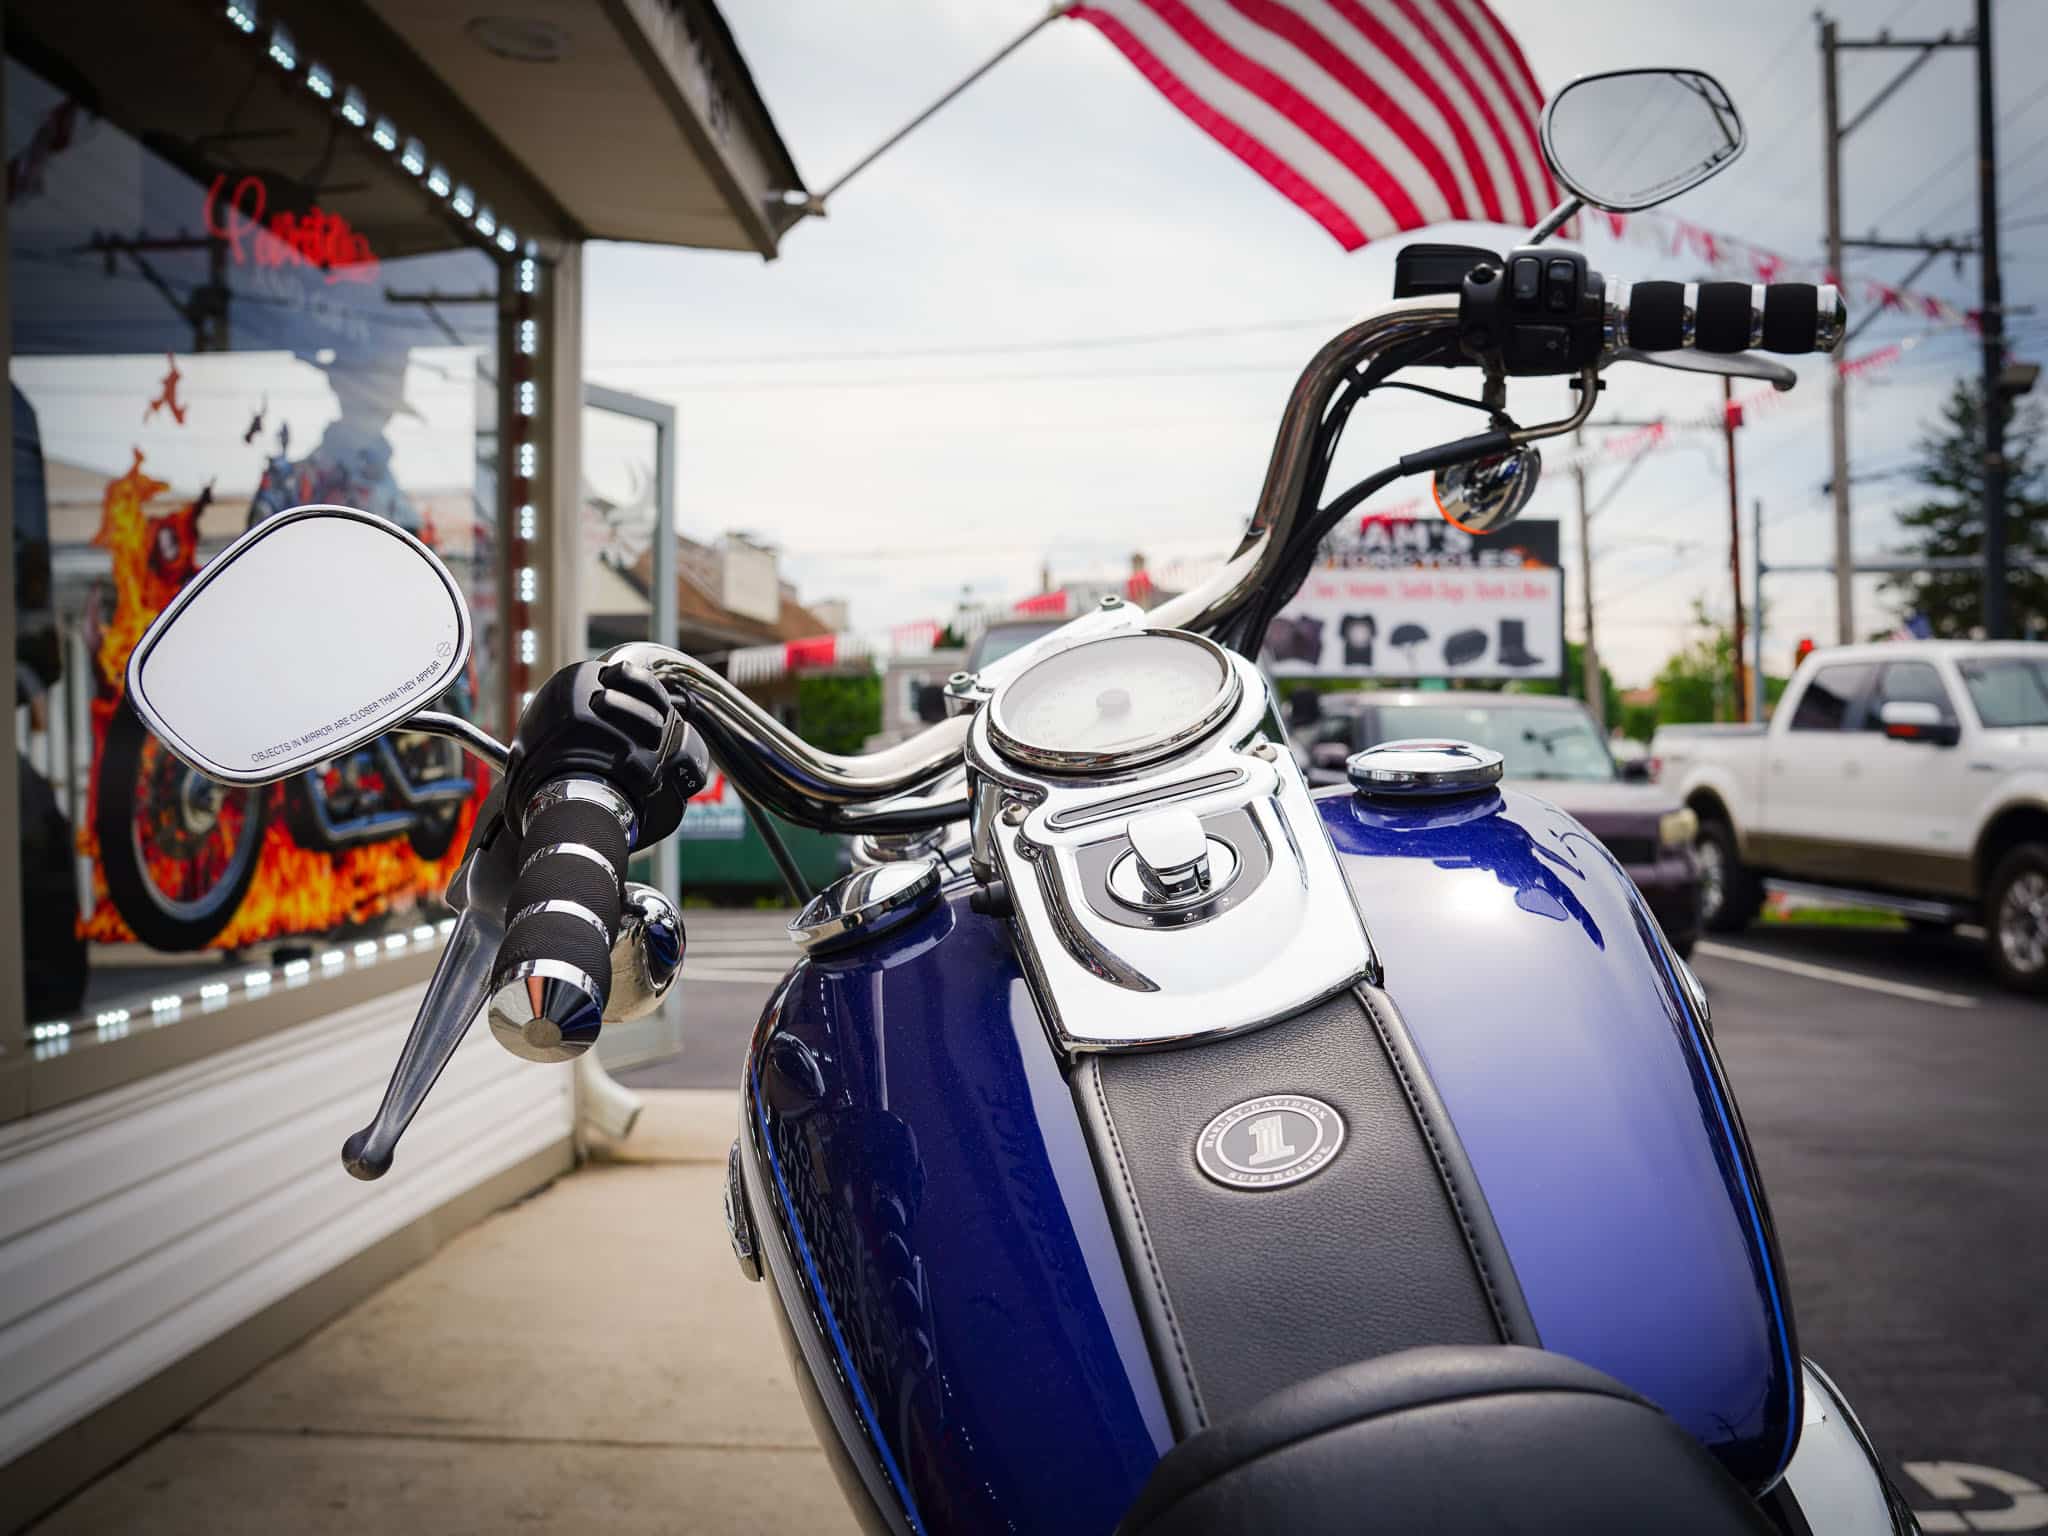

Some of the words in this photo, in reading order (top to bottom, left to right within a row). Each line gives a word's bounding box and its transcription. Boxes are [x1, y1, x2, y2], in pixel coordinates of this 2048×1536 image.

[251, 742, 292, 763] OBJECTS
[292, 738, 303, 749] IN
[301, 724, 334, 746] MIRROR
[334, 716, 350, 730] ARE
[350, 702, 380, 723] CLOSER
[378, 689, 399, 706] THAN
[398, 679, 417, 697] THEY
[415, 660, 441, 682] APPEAR
